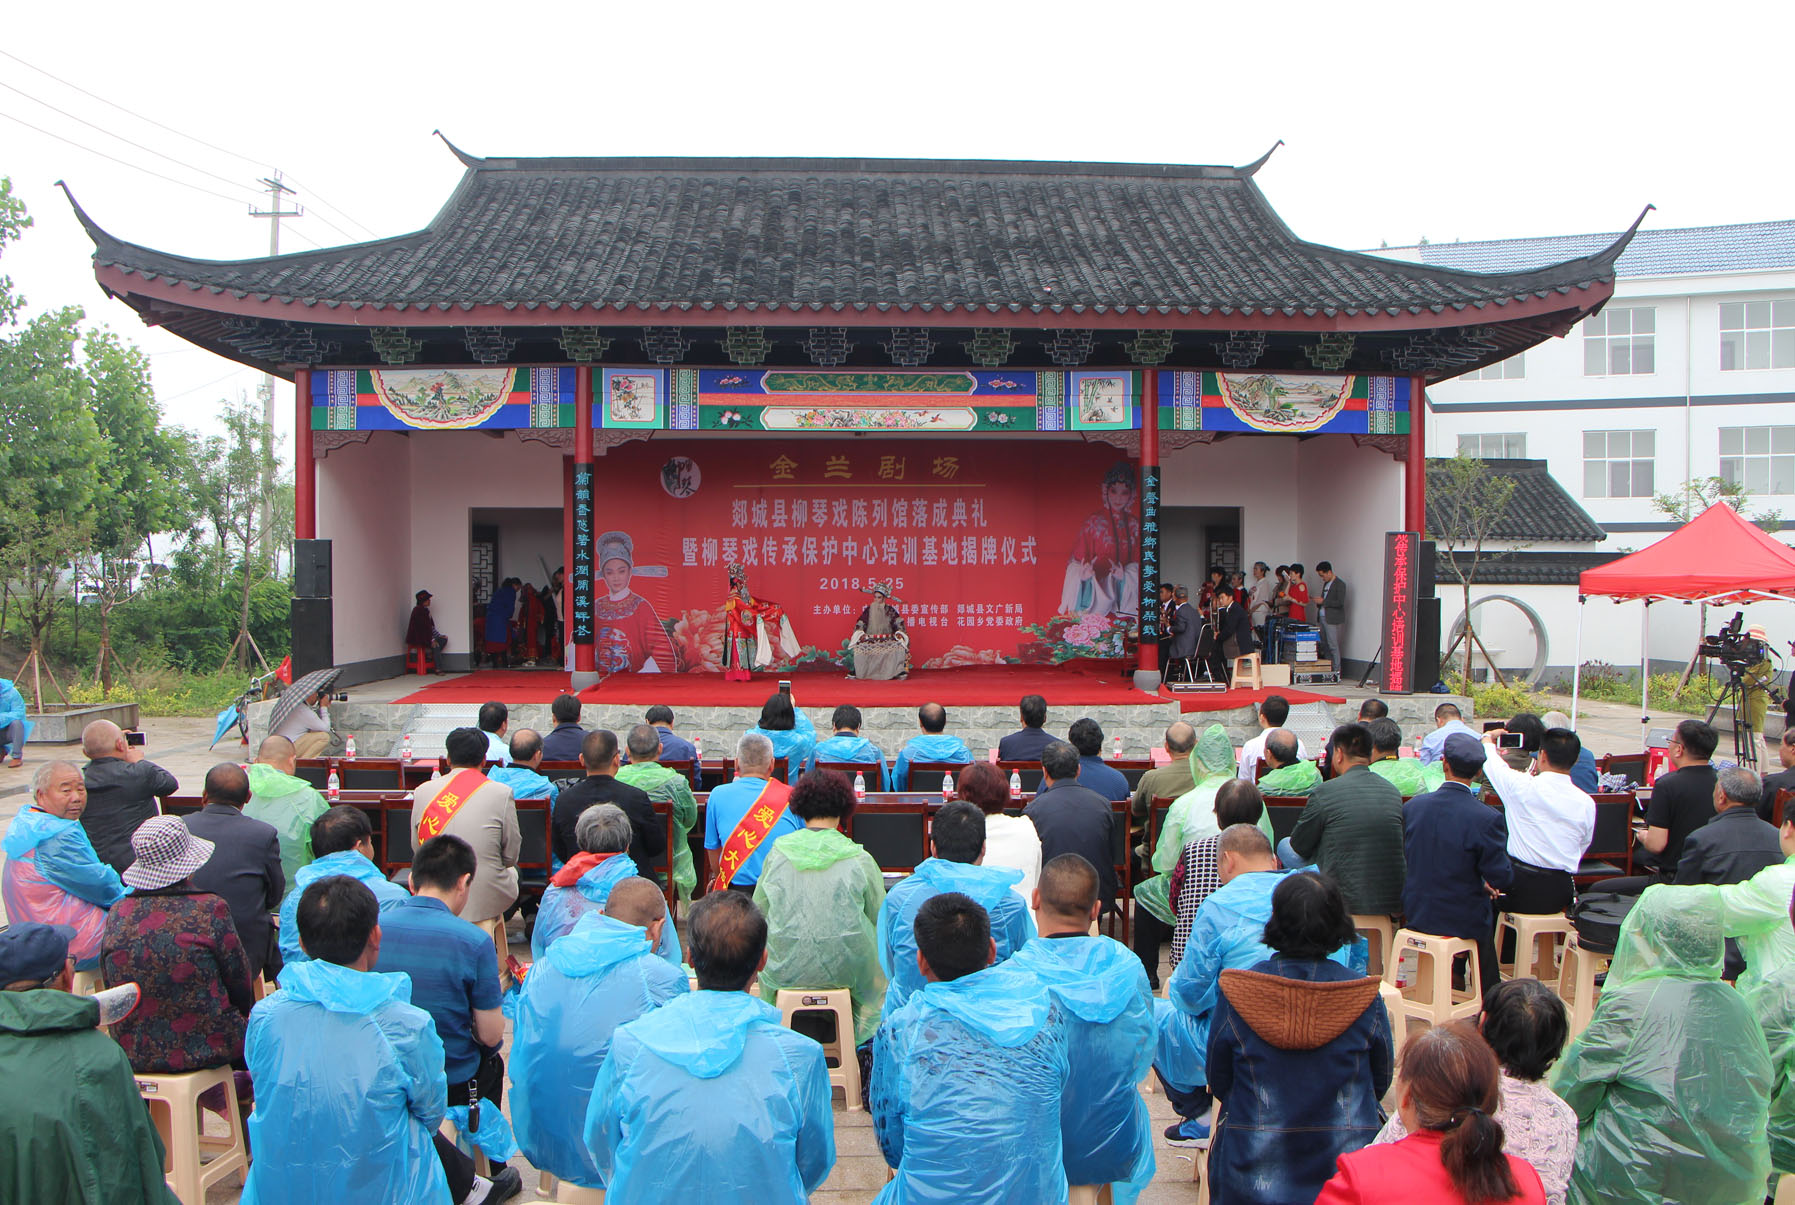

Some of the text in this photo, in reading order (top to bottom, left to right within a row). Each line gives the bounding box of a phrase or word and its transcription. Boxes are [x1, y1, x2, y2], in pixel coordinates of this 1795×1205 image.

[769, 454, 959, 480] 金兰剧场
[732, 498, 987, 528] 郯城县柳琴戏陈列馆落成典礼
[682, 535, 1038, 566] 暨柳琴戏传承保护中心培训基地揭牌仪式
[819, 577, 904, 590] 2018.525
[957, 603, 1023, 614] 郯城县文广新局
[957, 616, 1023, 627] 花园乡党委政府
[419, 792, 459, 845] 爱心
